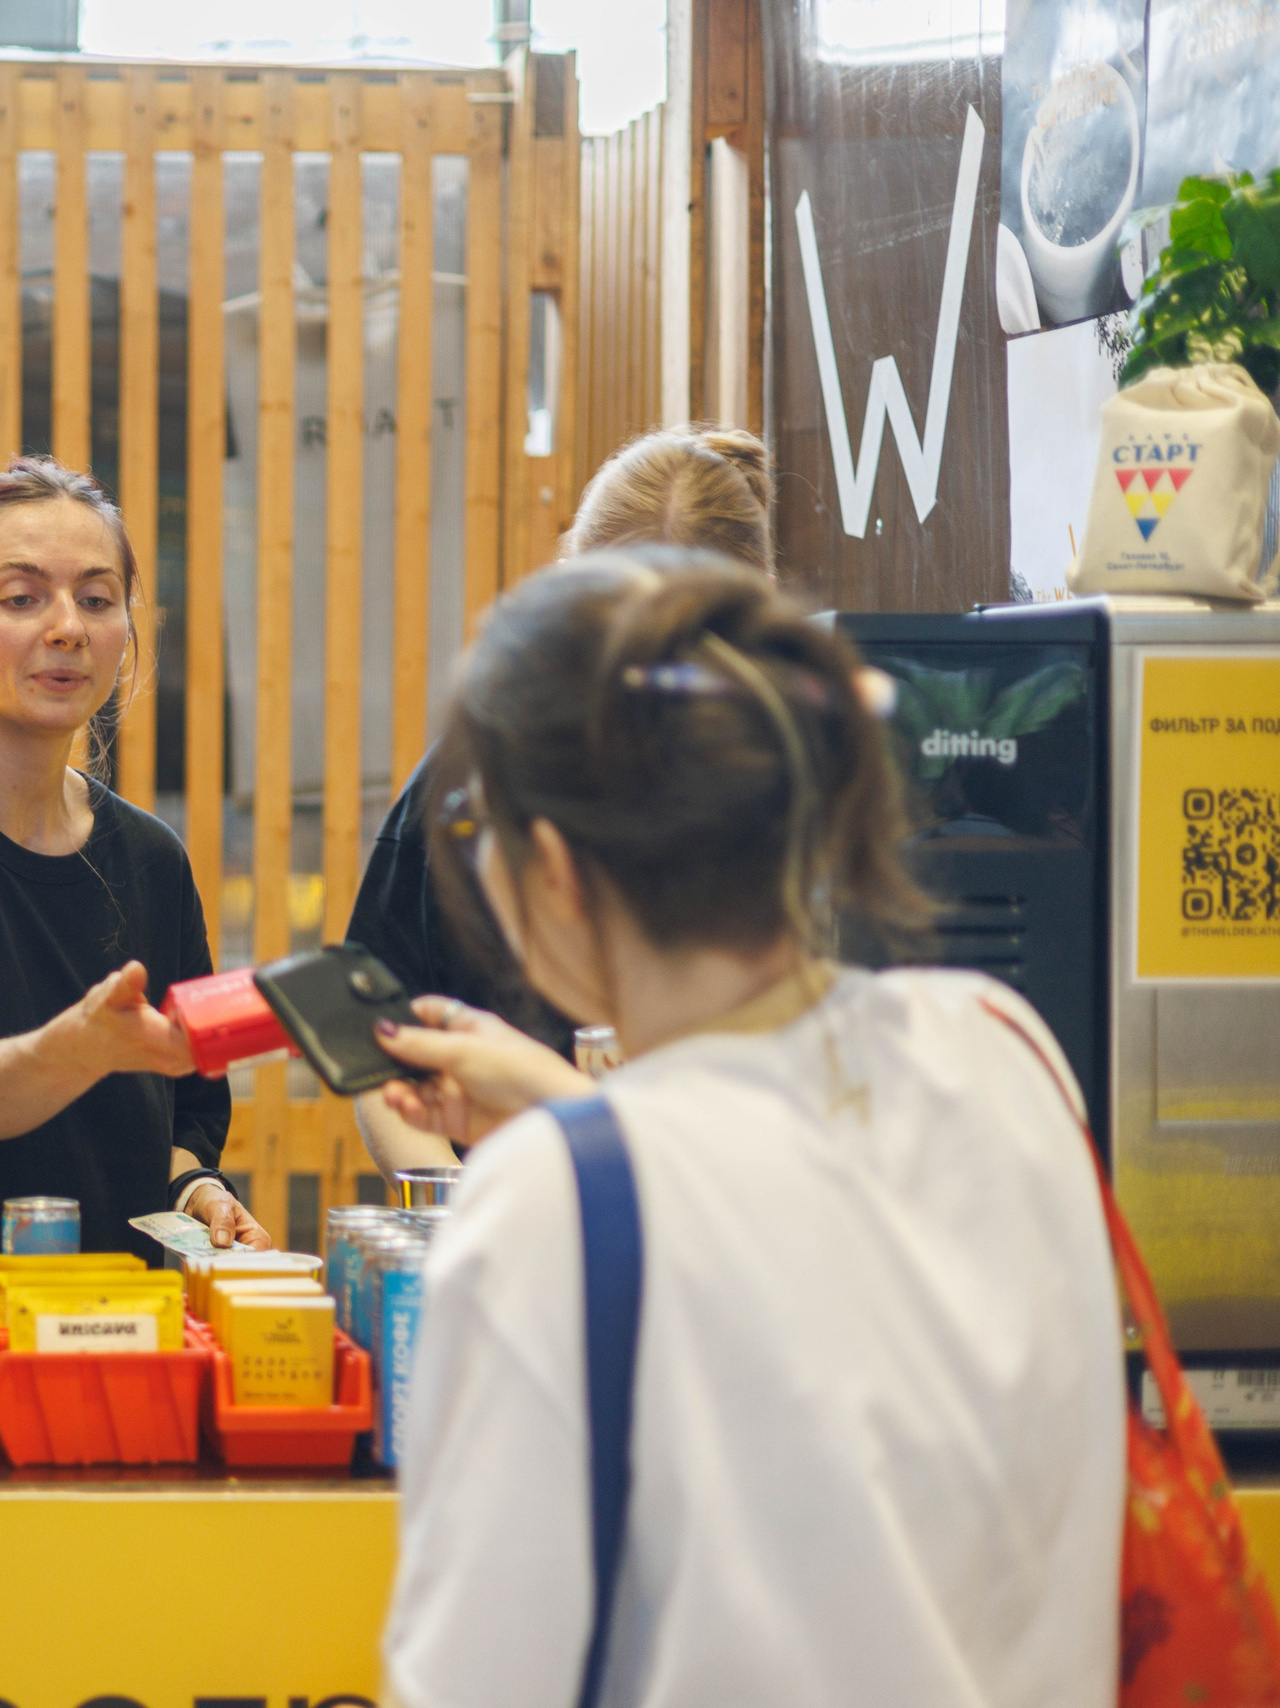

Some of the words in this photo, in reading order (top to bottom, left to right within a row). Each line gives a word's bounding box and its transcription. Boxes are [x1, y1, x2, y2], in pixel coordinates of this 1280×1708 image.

[795, 103, 985, 539] W
[1113, 444, 1203, 463] СТАРТ
[1150, 717, 1220, 733] ФИЛЬТР
[1225, 717, 1247, 733] ЗА
[921, 729, 1018, 765] ditting
